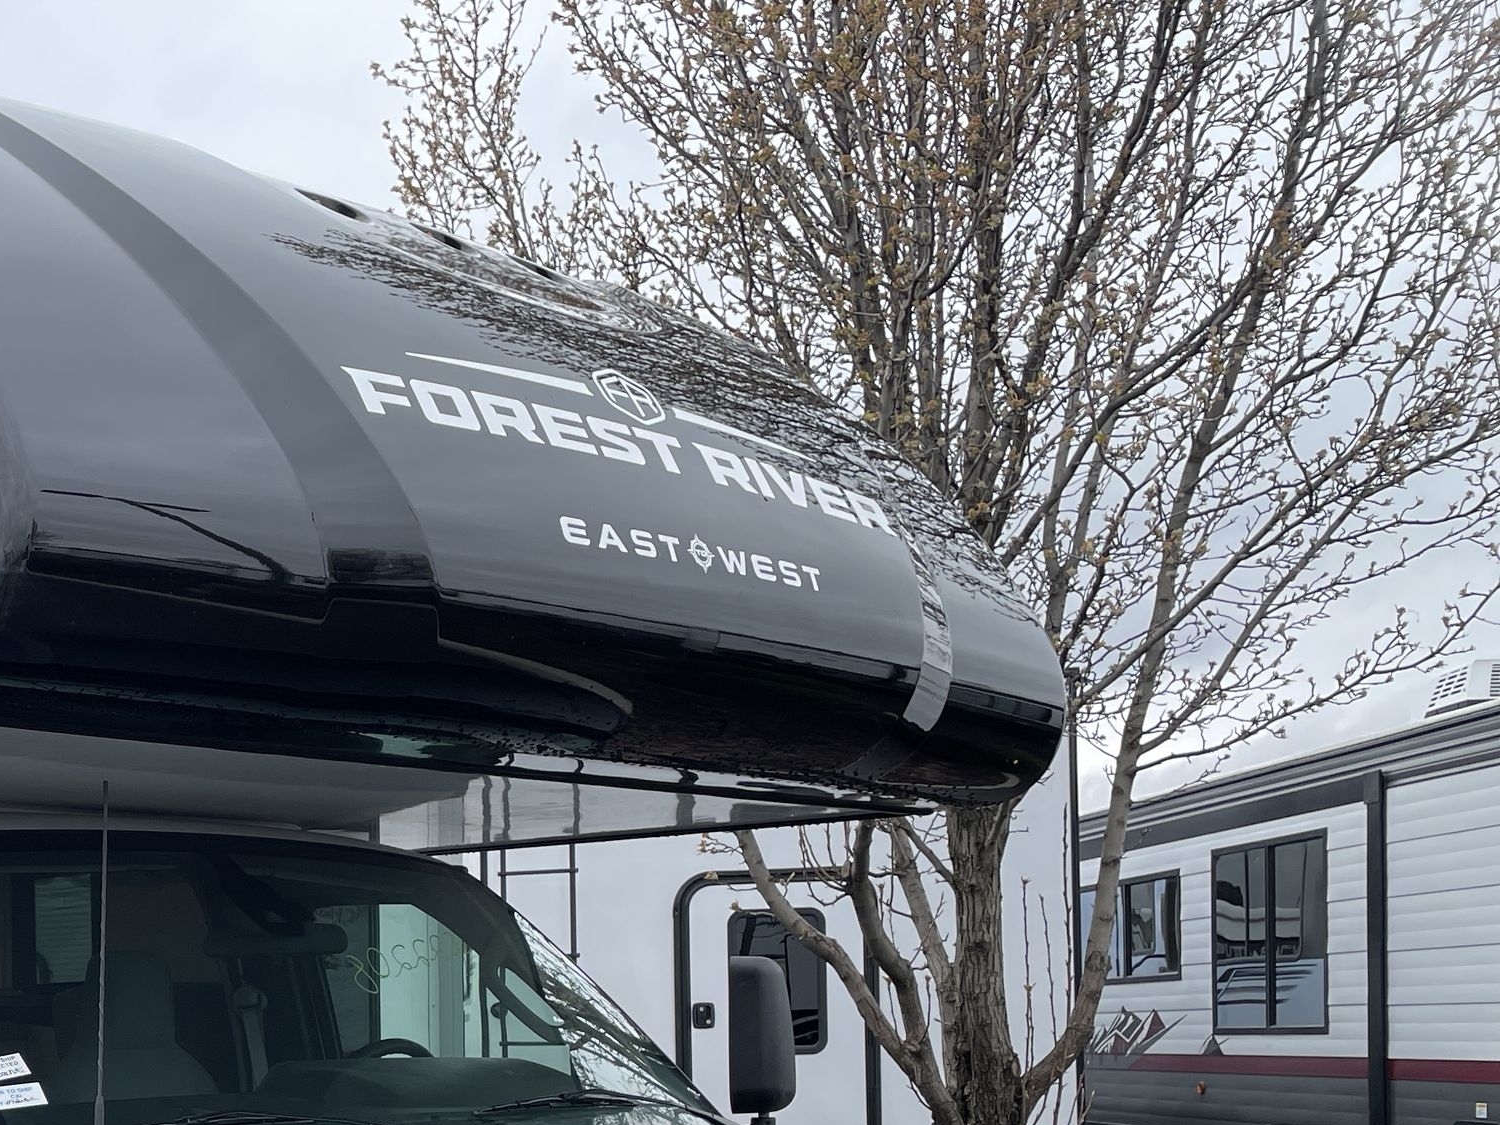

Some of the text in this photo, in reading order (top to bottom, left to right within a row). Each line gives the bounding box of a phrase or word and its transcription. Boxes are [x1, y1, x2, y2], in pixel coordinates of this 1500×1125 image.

[341, 366, 897, 537] FOREST RIVER
[559, 515, 680, 562] EAST
[716, 546, 821, 592] WEST
